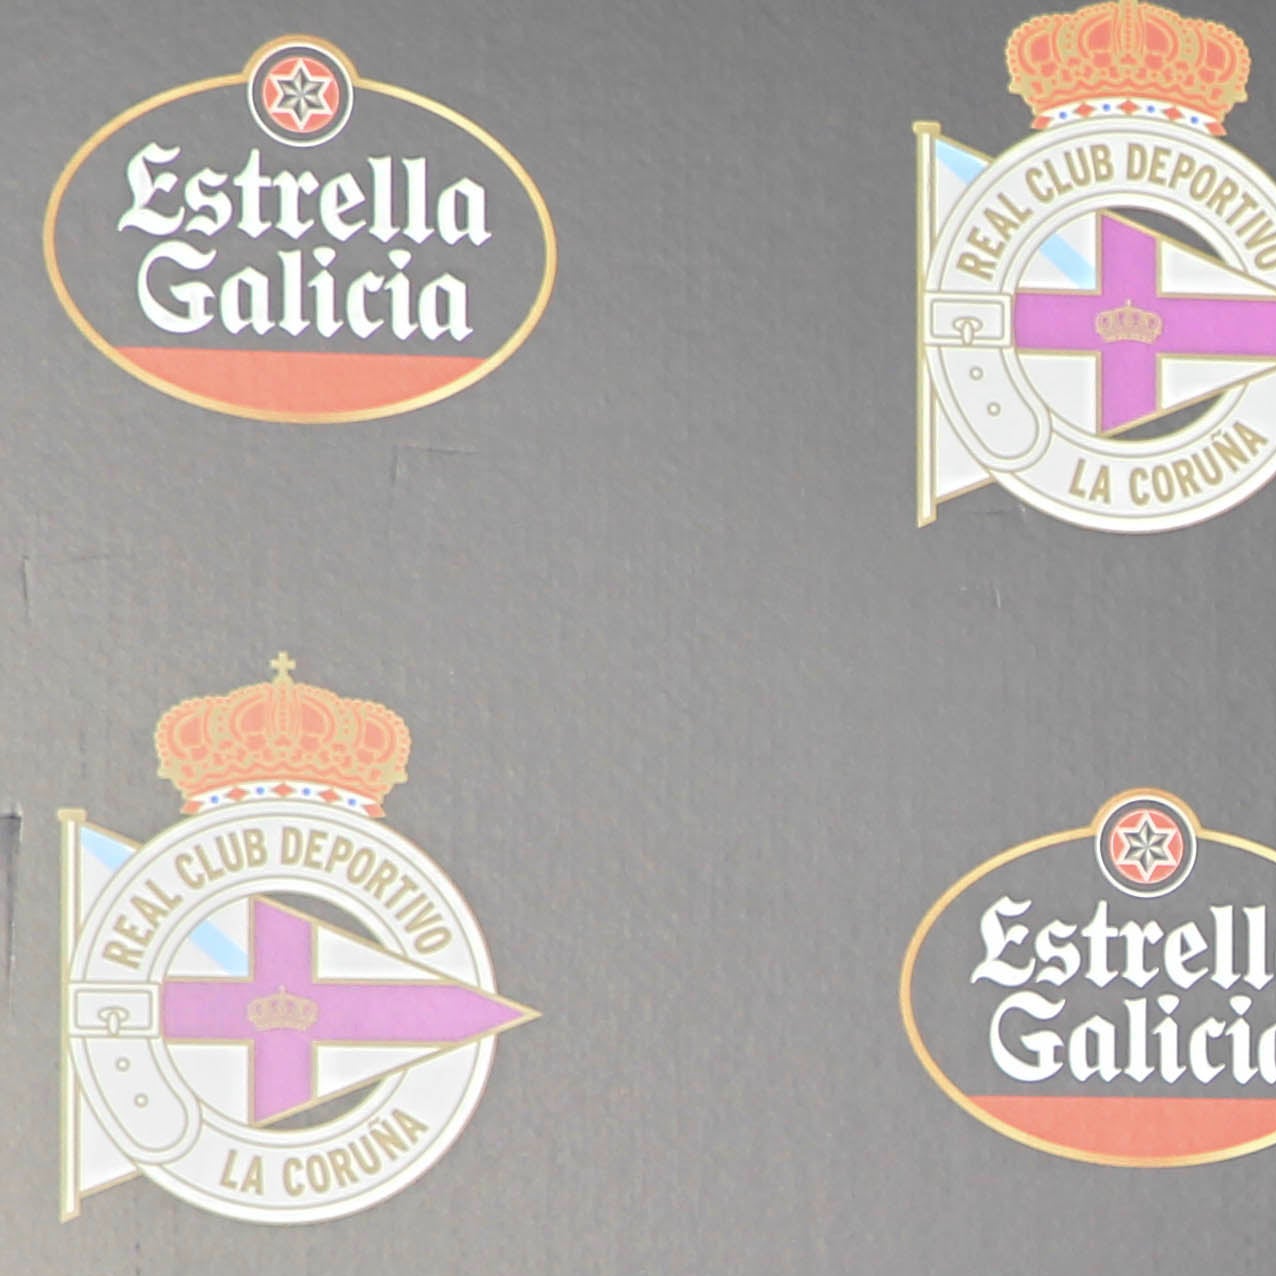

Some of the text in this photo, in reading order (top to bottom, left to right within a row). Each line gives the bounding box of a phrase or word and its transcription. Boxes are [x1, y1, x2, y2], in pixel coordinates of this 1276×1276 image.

[117, 142, 492, 246] Estrella
[956, 193, 1033, 281] REAL
[1025, 143, 1114, 204] CLUB
[137, 240, 474, 342] Galicia
[1068, 420, 1269, 506] LA CORUÑA
[102, 826, 453, 970] REAL CLUB DEPORTIVO
[219, 1107, 429, 1198] LA CORUÑA
